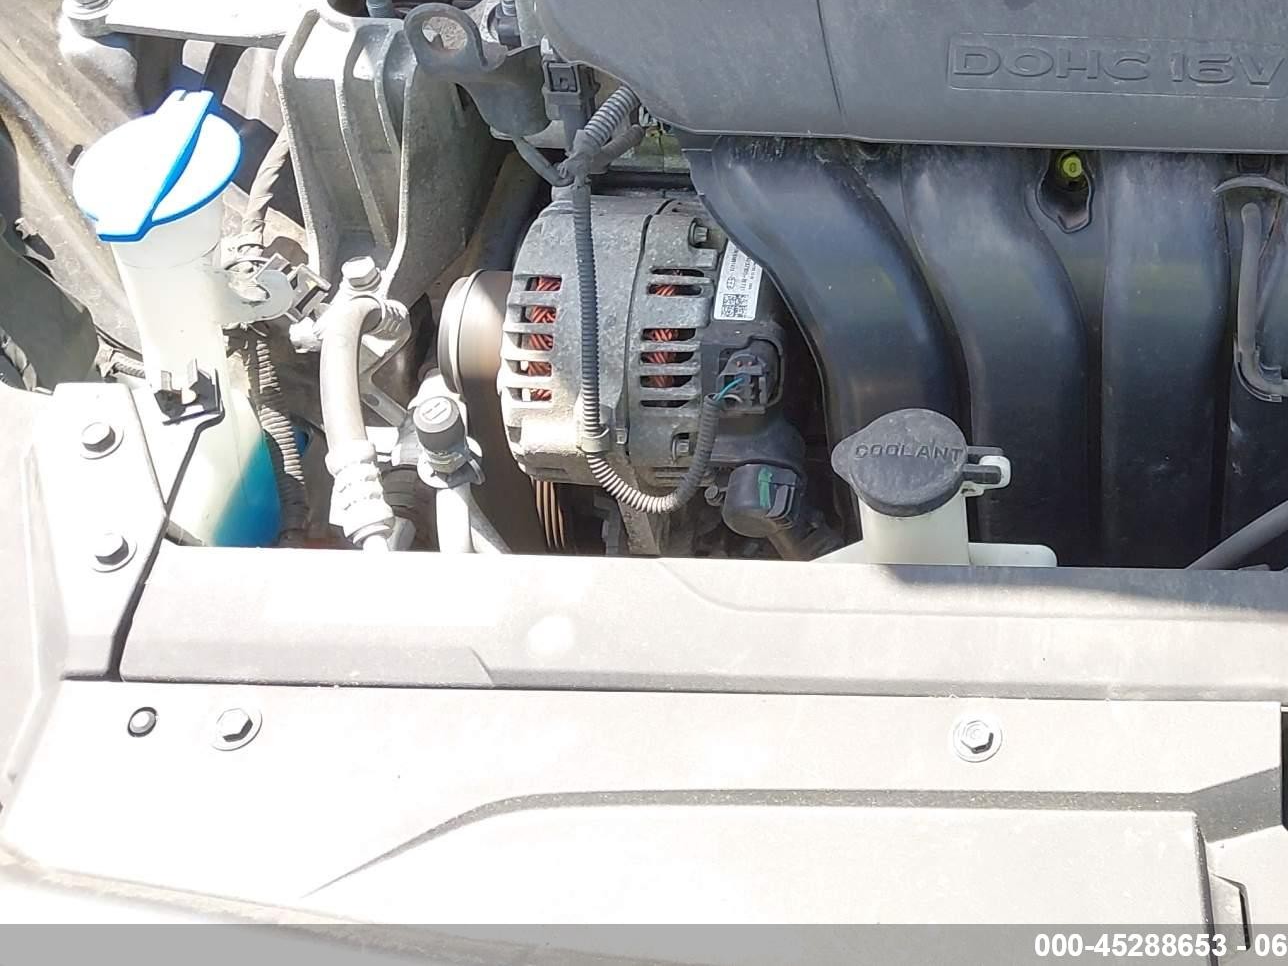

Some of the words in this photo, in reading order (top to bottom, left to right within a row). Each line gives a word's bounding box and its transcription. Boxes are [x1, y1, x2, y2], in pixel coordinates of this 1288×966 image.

[953, 45, 1151, 81] DOHC
[1169, 52, 1286, 86] 16V
[855, 442, 964, 462] COOLANT
